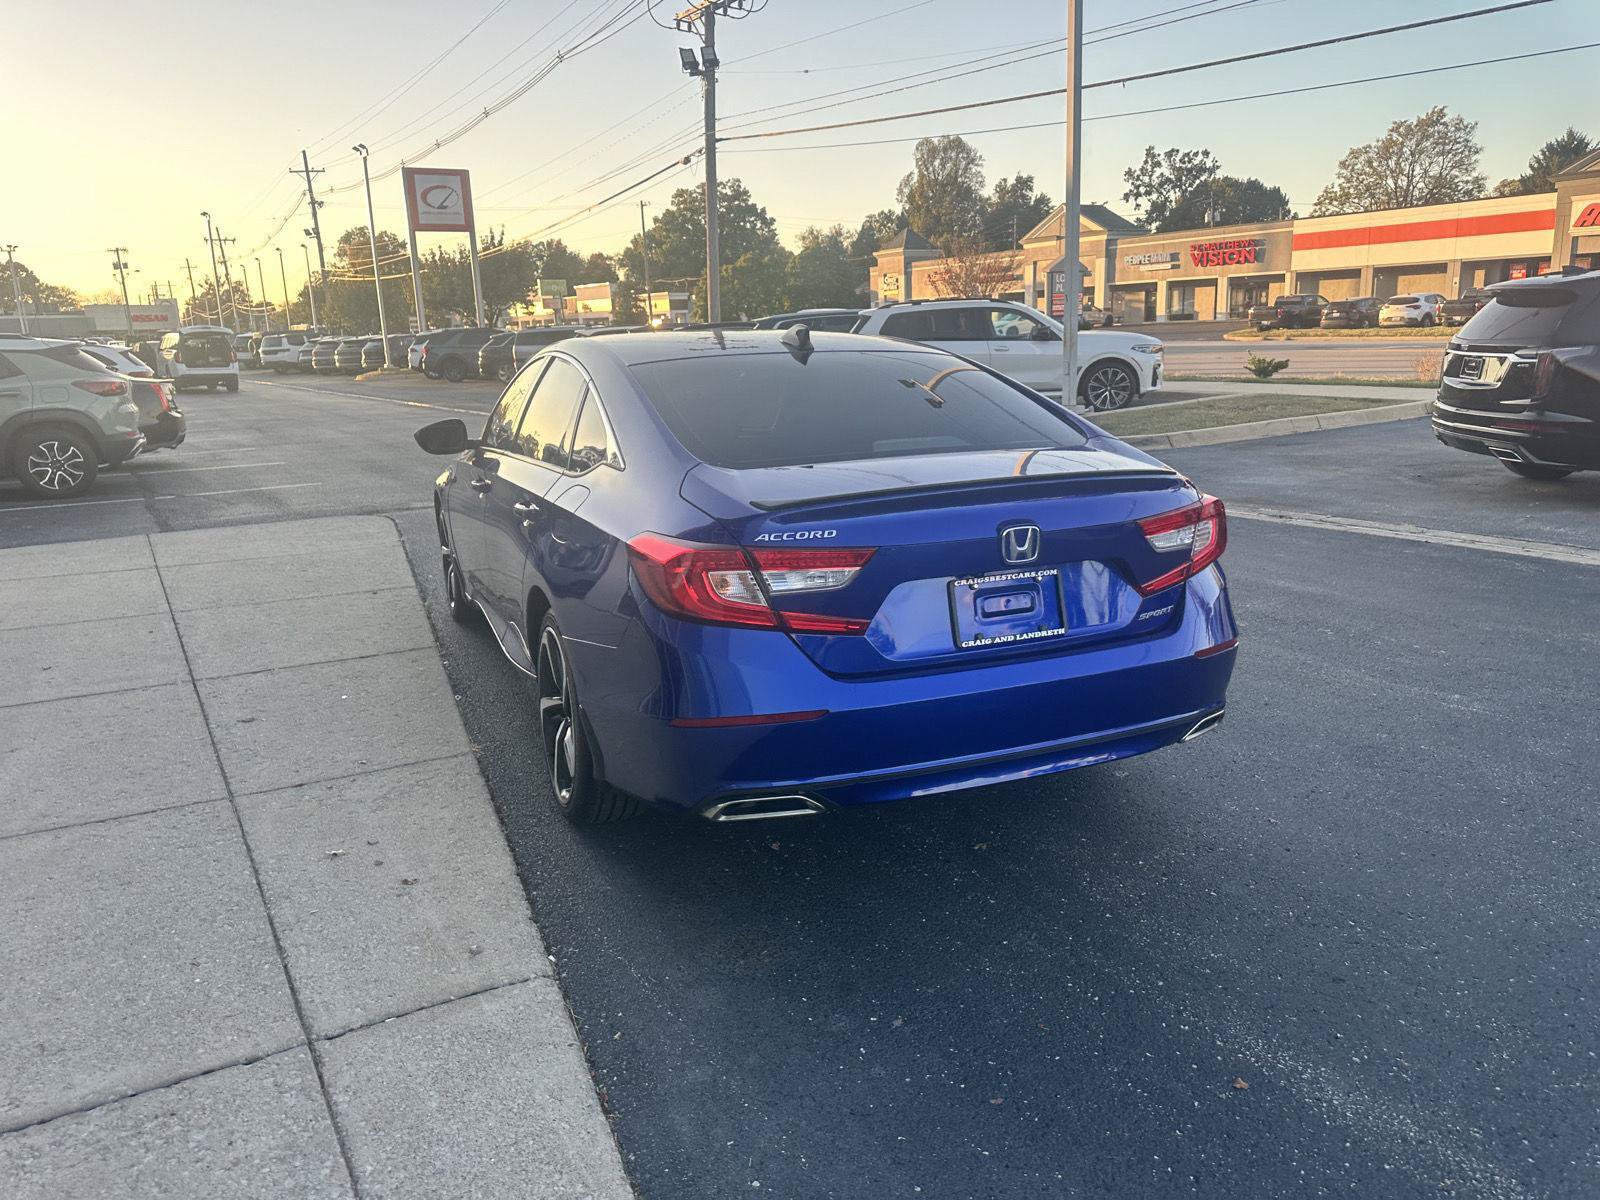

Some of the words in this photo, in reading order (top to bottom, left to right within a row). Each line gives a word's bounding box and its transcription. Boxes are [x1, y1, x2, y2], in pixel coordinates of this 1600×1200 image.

[1203, 239, 1255, 252] MATTHEWS
[1190, 247, 1255, 267] VISION
[754, 530, 837, 542] ACCORD
[954, 569, 1058, 587] CRAIGSBESTCARS.COM
[1138, 604, 1174, 620] SPORT
[961, 638, 992, 648] CRAIG
[994, 635, 1014, 643] AND
[1016, 628, 1066, 641] LANDRETH
